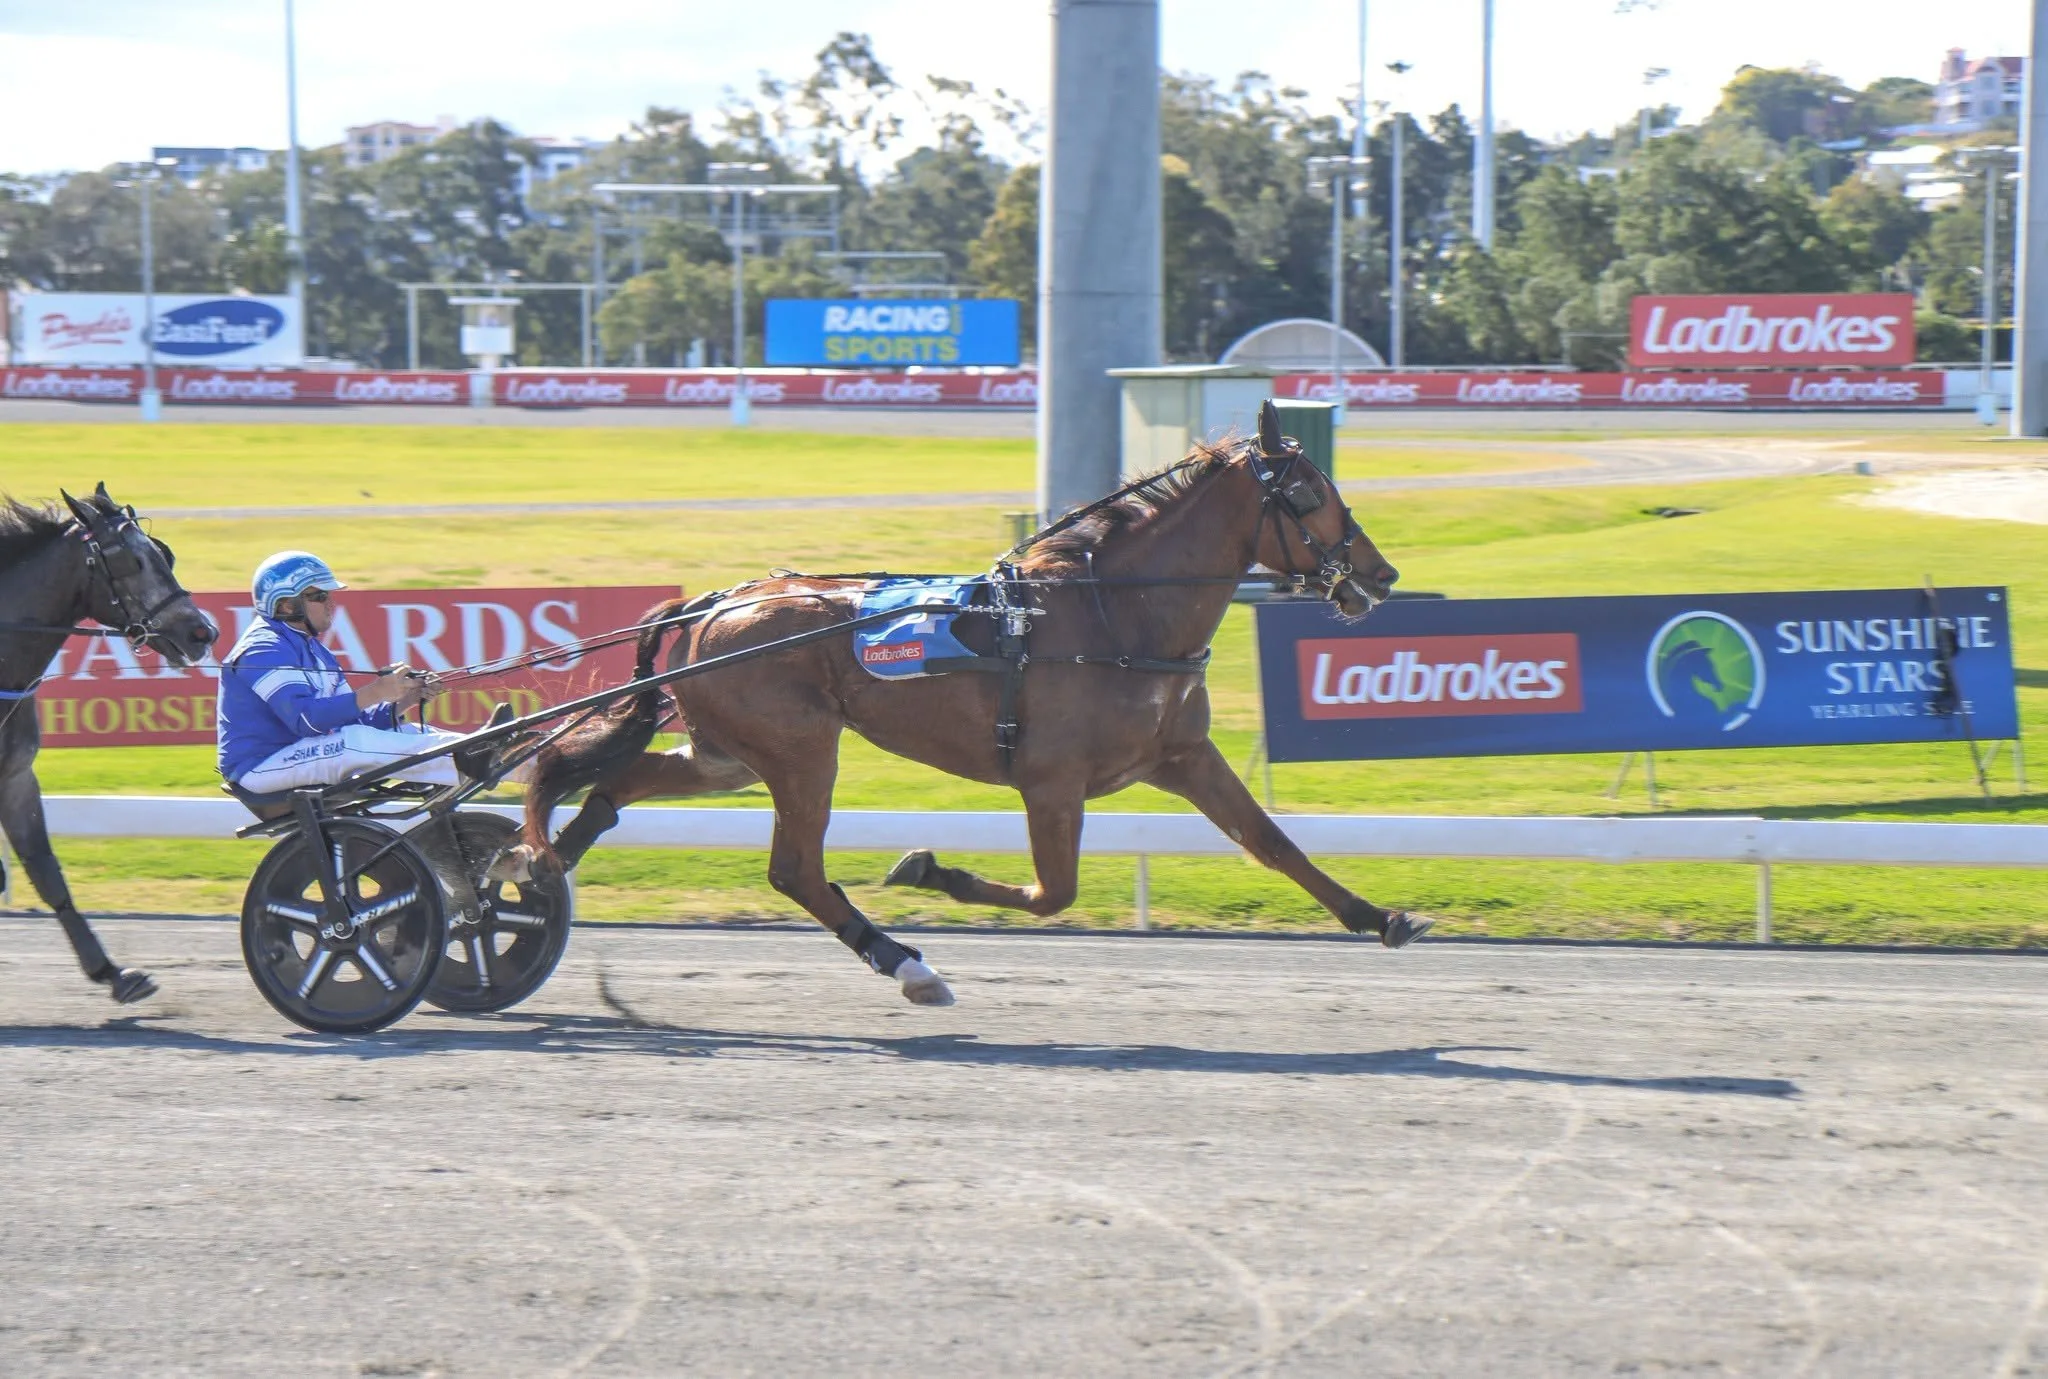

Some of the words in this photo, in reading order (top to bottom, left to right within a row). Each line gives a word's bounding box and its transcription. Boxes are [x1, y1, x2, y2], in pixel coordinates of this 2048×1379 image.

[152, 316, 274, 343] EasiFeed
[824, 306, 950, 332] RACING
[1643, 305, 1901, 354] Ladbrokes
[825, 335, 960, 361] SPORTS
[3, 372, 132, 398] Ladbrokes
[171, 374, 298, 400] Ladbrokes
[334, 376, 459, 401] Ladbrokes
[507, 377, 629, 402] Ladbrokes
[822, 377, 944, 402] Ladbrokes
[1456, 378, 1583, 403] Ladbrokes
[1621, 377, 1751, 402] Ladbrokes
[1789, 377, 1922, 402] Ladbrokes
[864, 645, 920, 662] Ladbrokes
[1312, 649, 1568, 705] Ladbrokes
[1826, 660, 1947, 695] STARS
[41, 695, 217, 735] HORSE
[1808, 702, 1916, 719] YEARLING
[1922, 700, 1977, 717] SE
